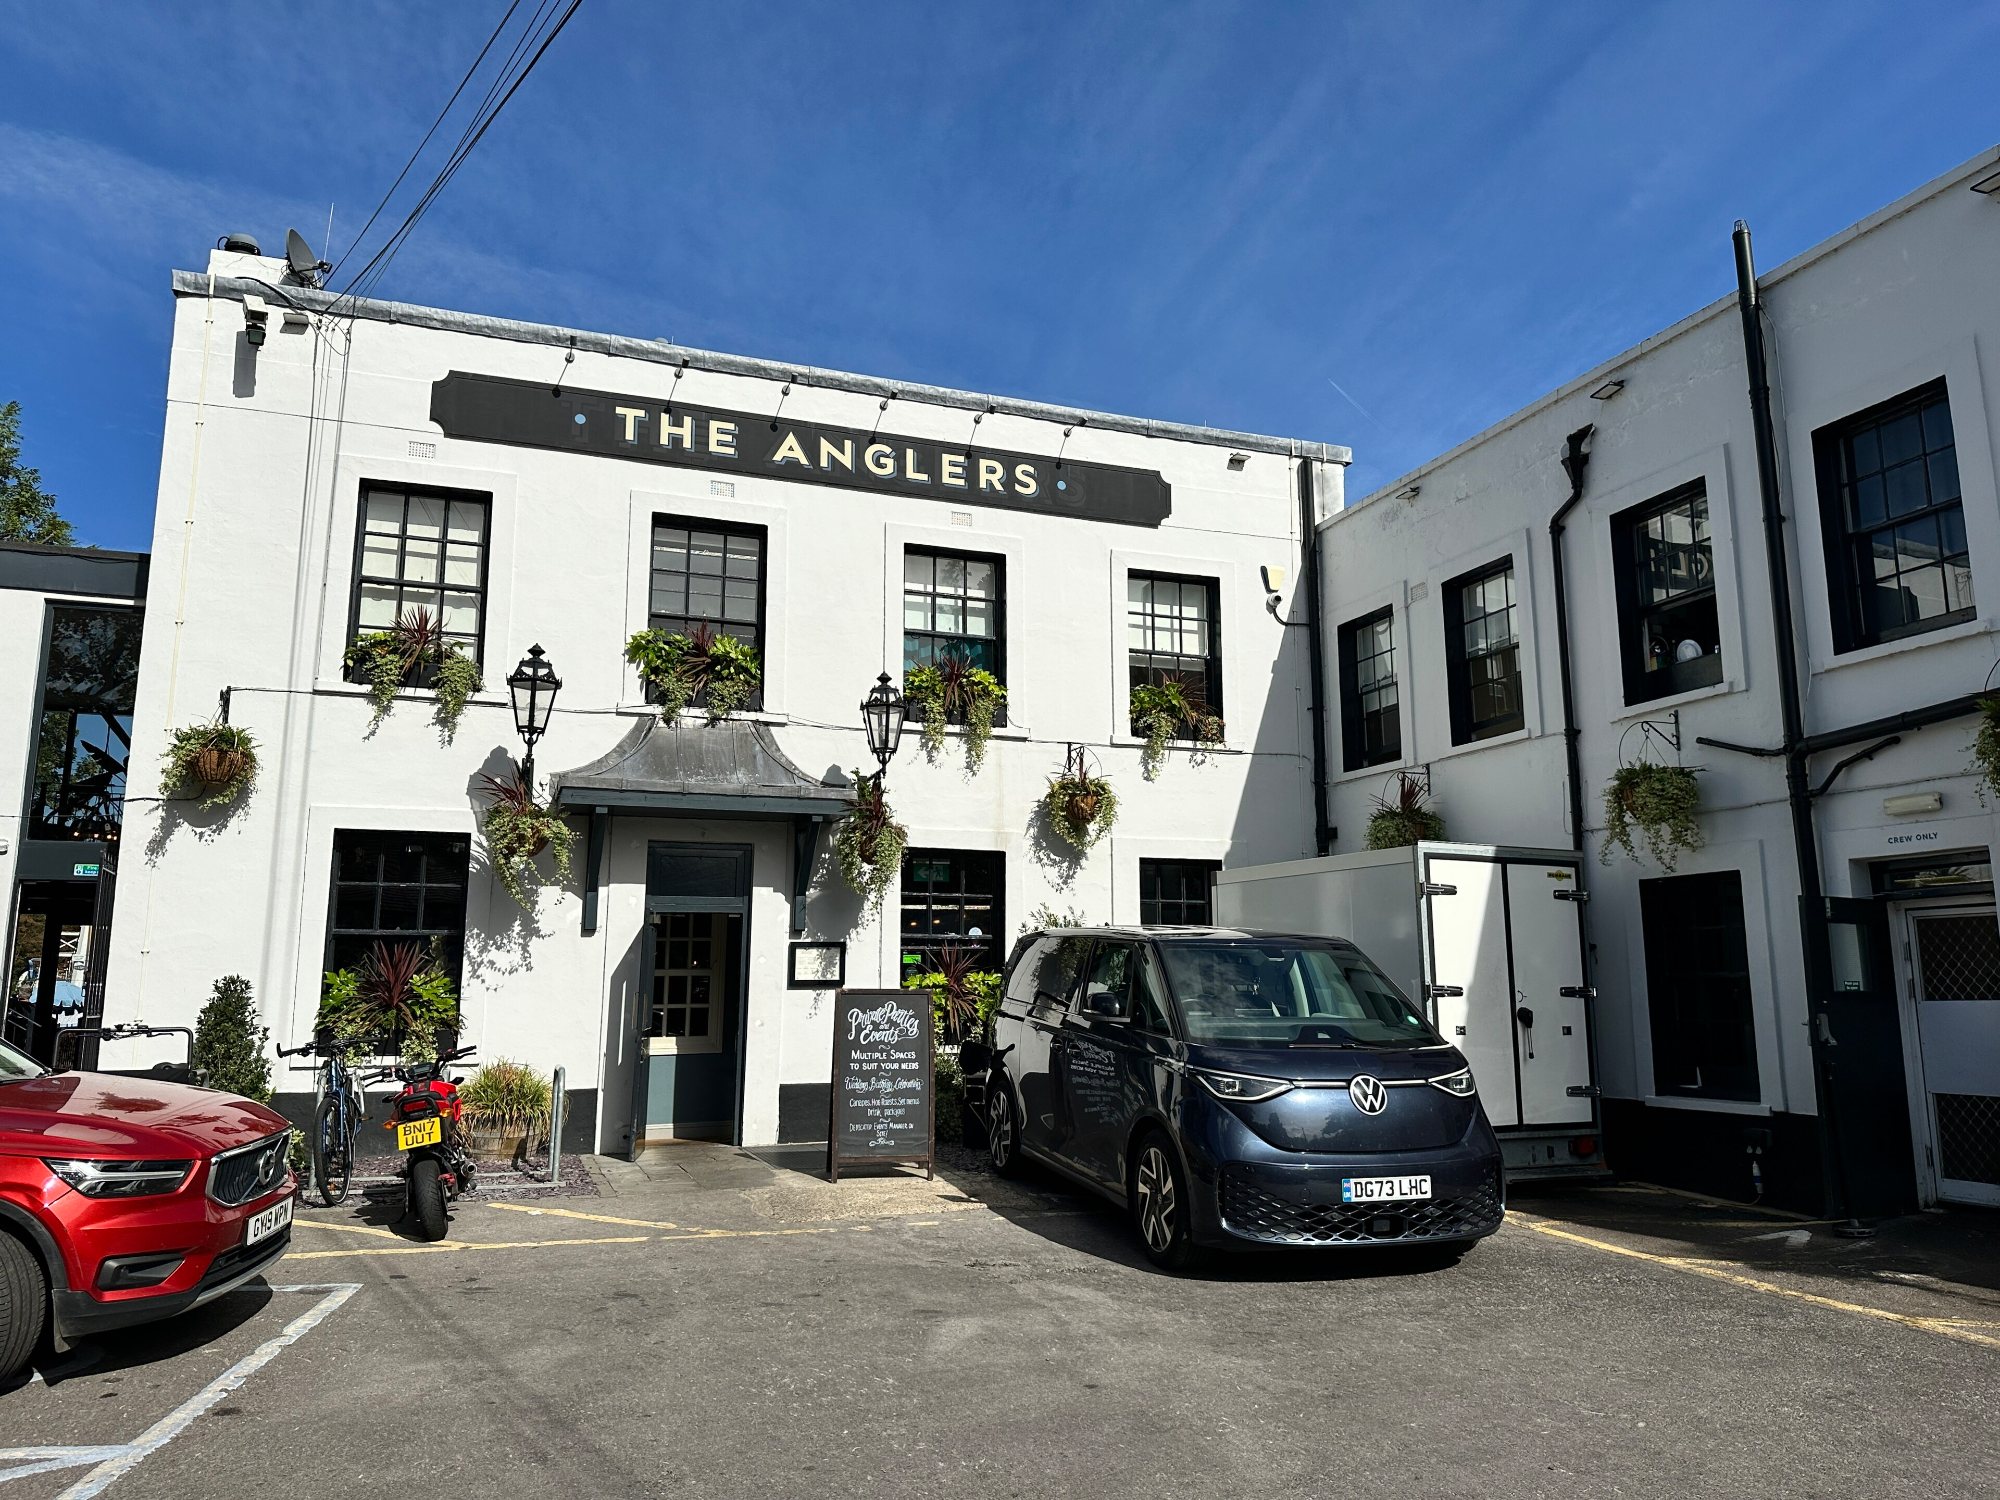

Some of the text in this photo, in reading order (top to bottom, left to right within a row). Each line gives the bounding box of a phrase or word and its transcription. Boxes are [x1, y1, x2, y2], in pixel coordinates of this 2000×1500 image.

[615, 406, 1039, 498] THE ANGLERS
[1887, 832, 1938, 844] CREW ONLY
[847, 1001, 920, 1040] Private Parties
[860, 1025, 898, 1045] Events
[851, 1050, 916, 1060] MULTIPLE SPACES
[901, 1062, 919, 1070] NEEDS
[403, 1121, 436, 1136] BN17
[405, 1132, 434, 1146] UUT
[1354, 1180, 1395, 1198] DG73
[1399, 1178, 1428, 1196] LHC
[253, 1202, 289, 1237] GY19 WPN
